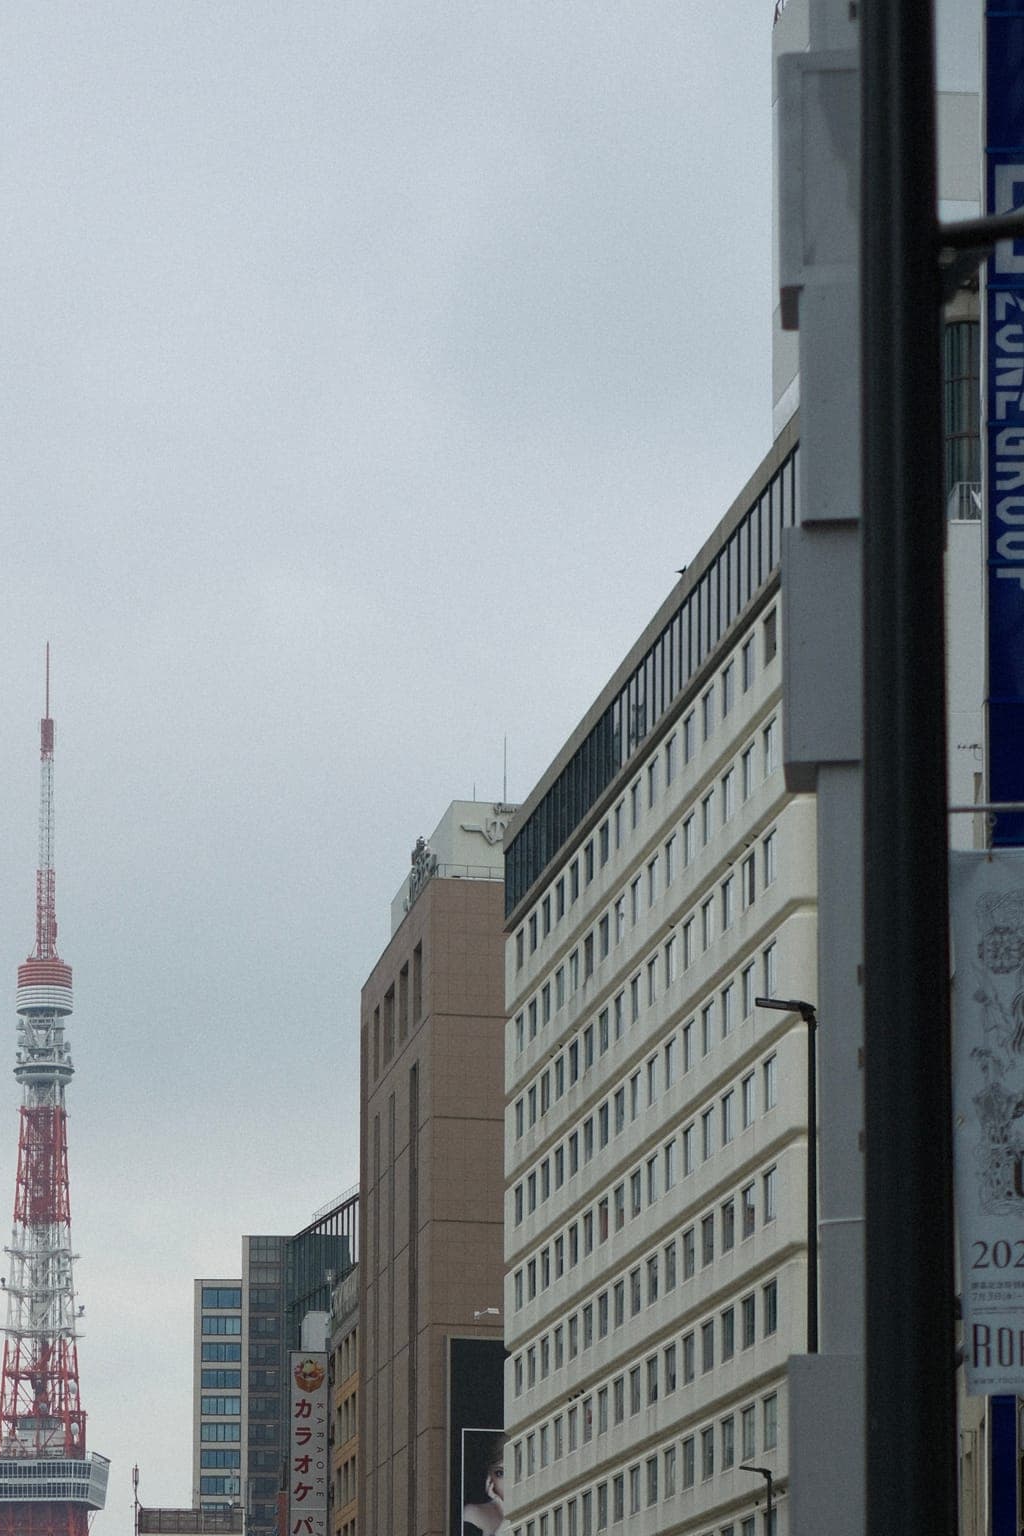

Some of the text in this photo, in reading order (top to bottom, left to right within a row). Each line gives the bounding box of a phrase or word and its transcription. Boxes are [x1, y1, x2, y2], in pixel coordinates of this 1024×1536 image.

[972, 1323, 1024, 1368] RO
[294, 1399, 313, 1502] カラオケ
[316, 1402, 325, 1498] KARAOKE
